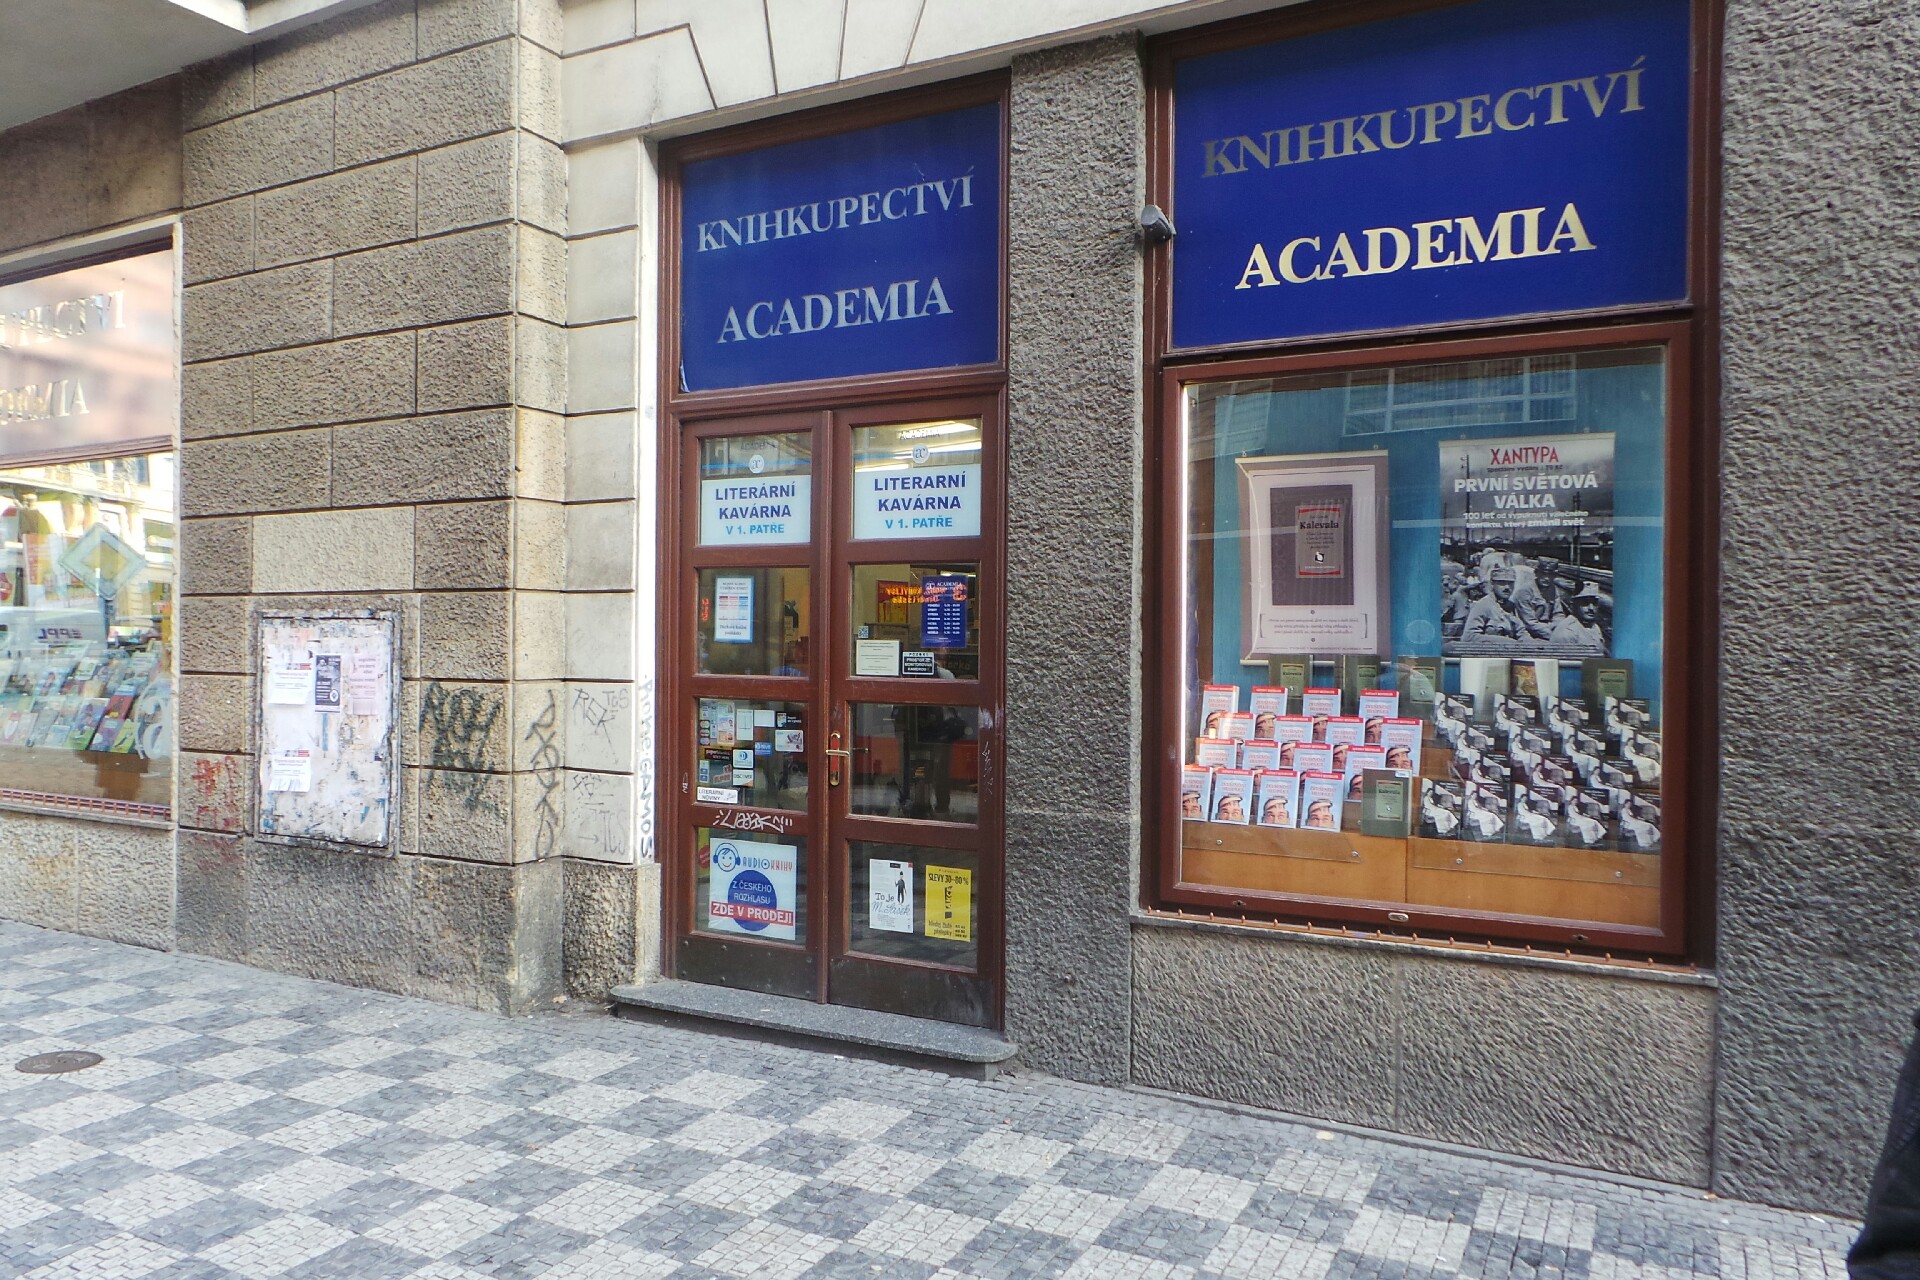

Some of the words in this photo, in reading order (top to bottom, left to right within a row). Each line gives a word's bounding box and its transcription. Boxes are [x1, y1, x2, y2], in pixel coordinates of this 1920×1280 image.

[1201, 55, 1646, 179] KNIHKUPECTVÍ
[697, 165, 974, 252] KNIHKUPECTVÍ
[1235, 203, 1597, 290] ACADEMIA
[717, 276, 953, 343] ACADEMIA
[1490, 446, 1559, 465] XANTYPA
[1454, 475, 1508, 492] PRVNÍ
[1512, 470, 1598, 490] SVĚTOVÁ
[715, 481, 796, 500] LITERÁRNÍ
[878, 494, 962, 512] KAVÁRNA
[1494, 492, 1556, 509] VÁLKA
[719, 504, 792, 520] KAVÁRNA
[726, 525, 734, 535] V
[737, 526, 746, 535] 1.
[750, 522, 785, 534] PATŘE
[885, 519, 894, 529] V
[897, 518, 908, 528] 1.
[912, 516, 953, 528] PATŘE
[1300, 520, 1340, 530] Kalevala
[742, 857, 793, 871] AUDIOKNIHY
[732, 881, 738, 889] Z
[928, 874, 944, 882] SLEVY
[734, 893, 771, 904] ROZHLASU
[712, 903, 734, 915] ZDE
[738, 906, 744, 916] V
